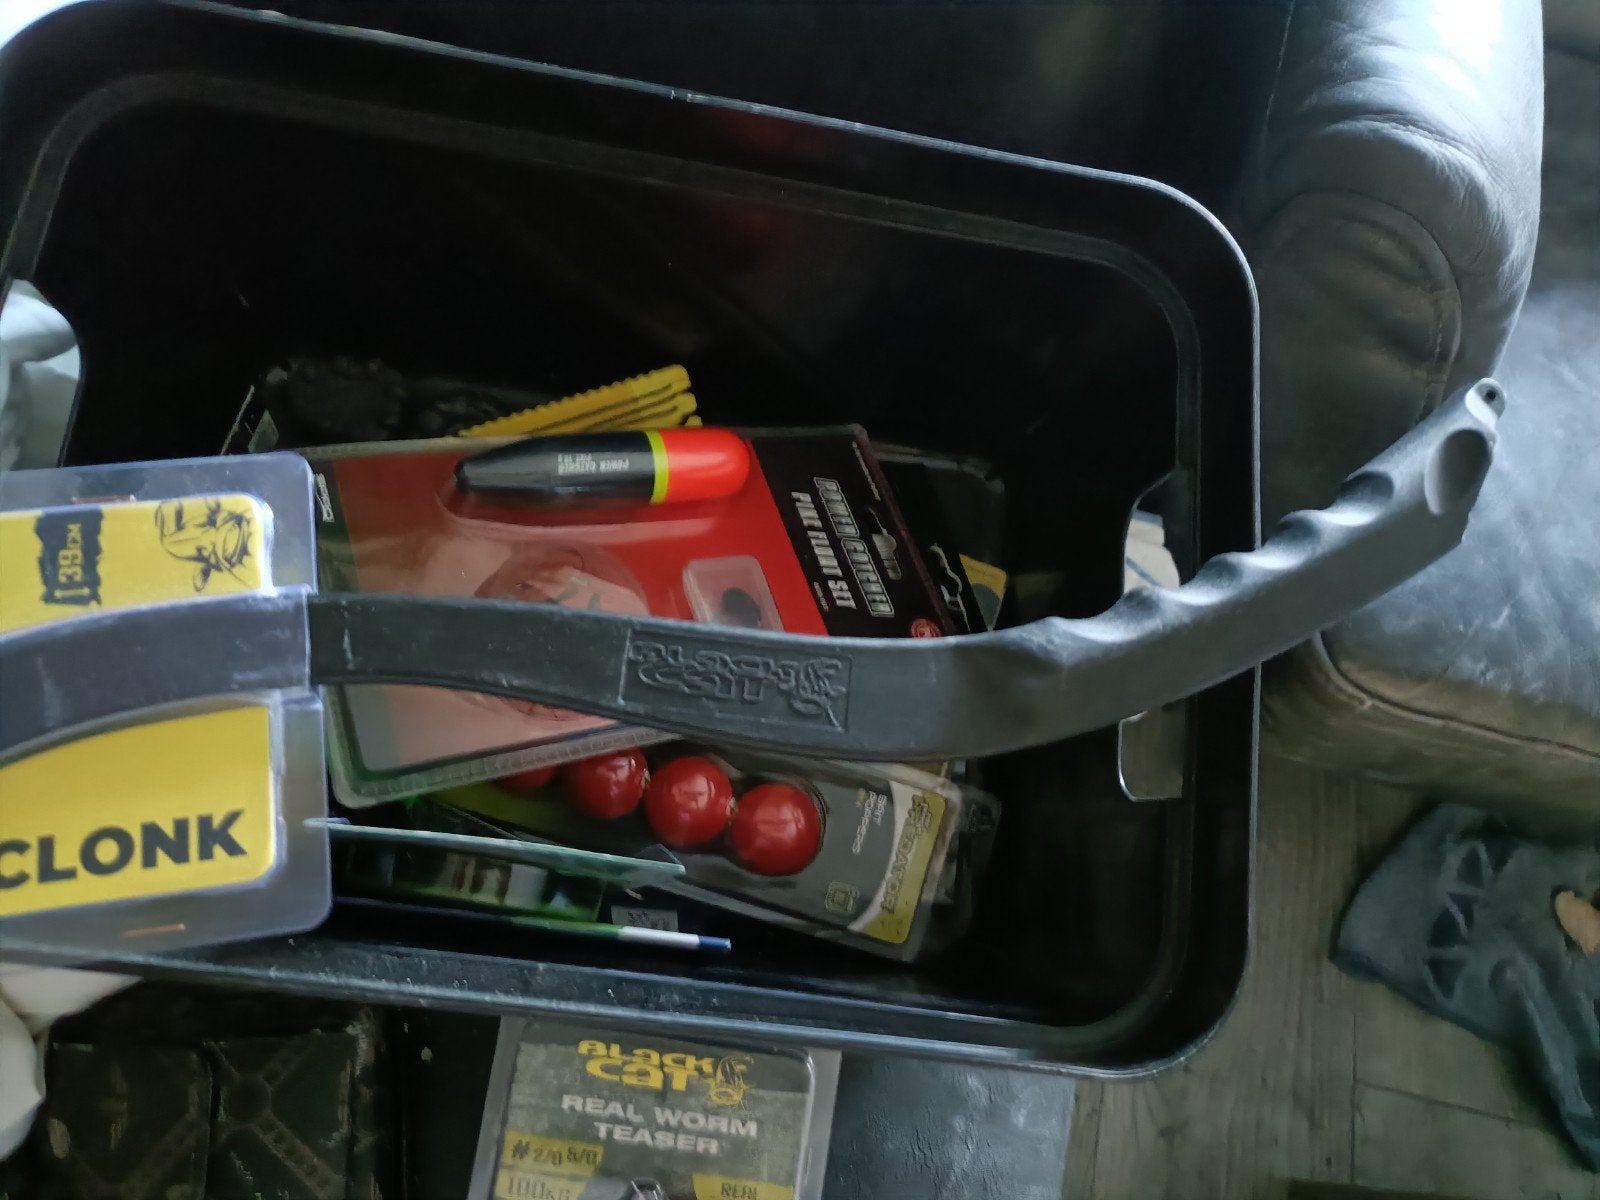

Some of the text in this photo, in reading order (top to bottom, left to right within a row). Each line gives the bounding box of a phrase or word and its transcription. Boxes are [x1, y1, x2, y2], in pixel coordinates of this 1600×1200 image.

[815, 479, 857, 535] POWER
[807, 531, 842, 577] FLOAT
[828, 579, 857, 609] SET
[0, 809, 247, 888] CLONK
[561, 1094, 758, 1140] REAL WORM
[594, 1121, 719, 1155] TEASER
